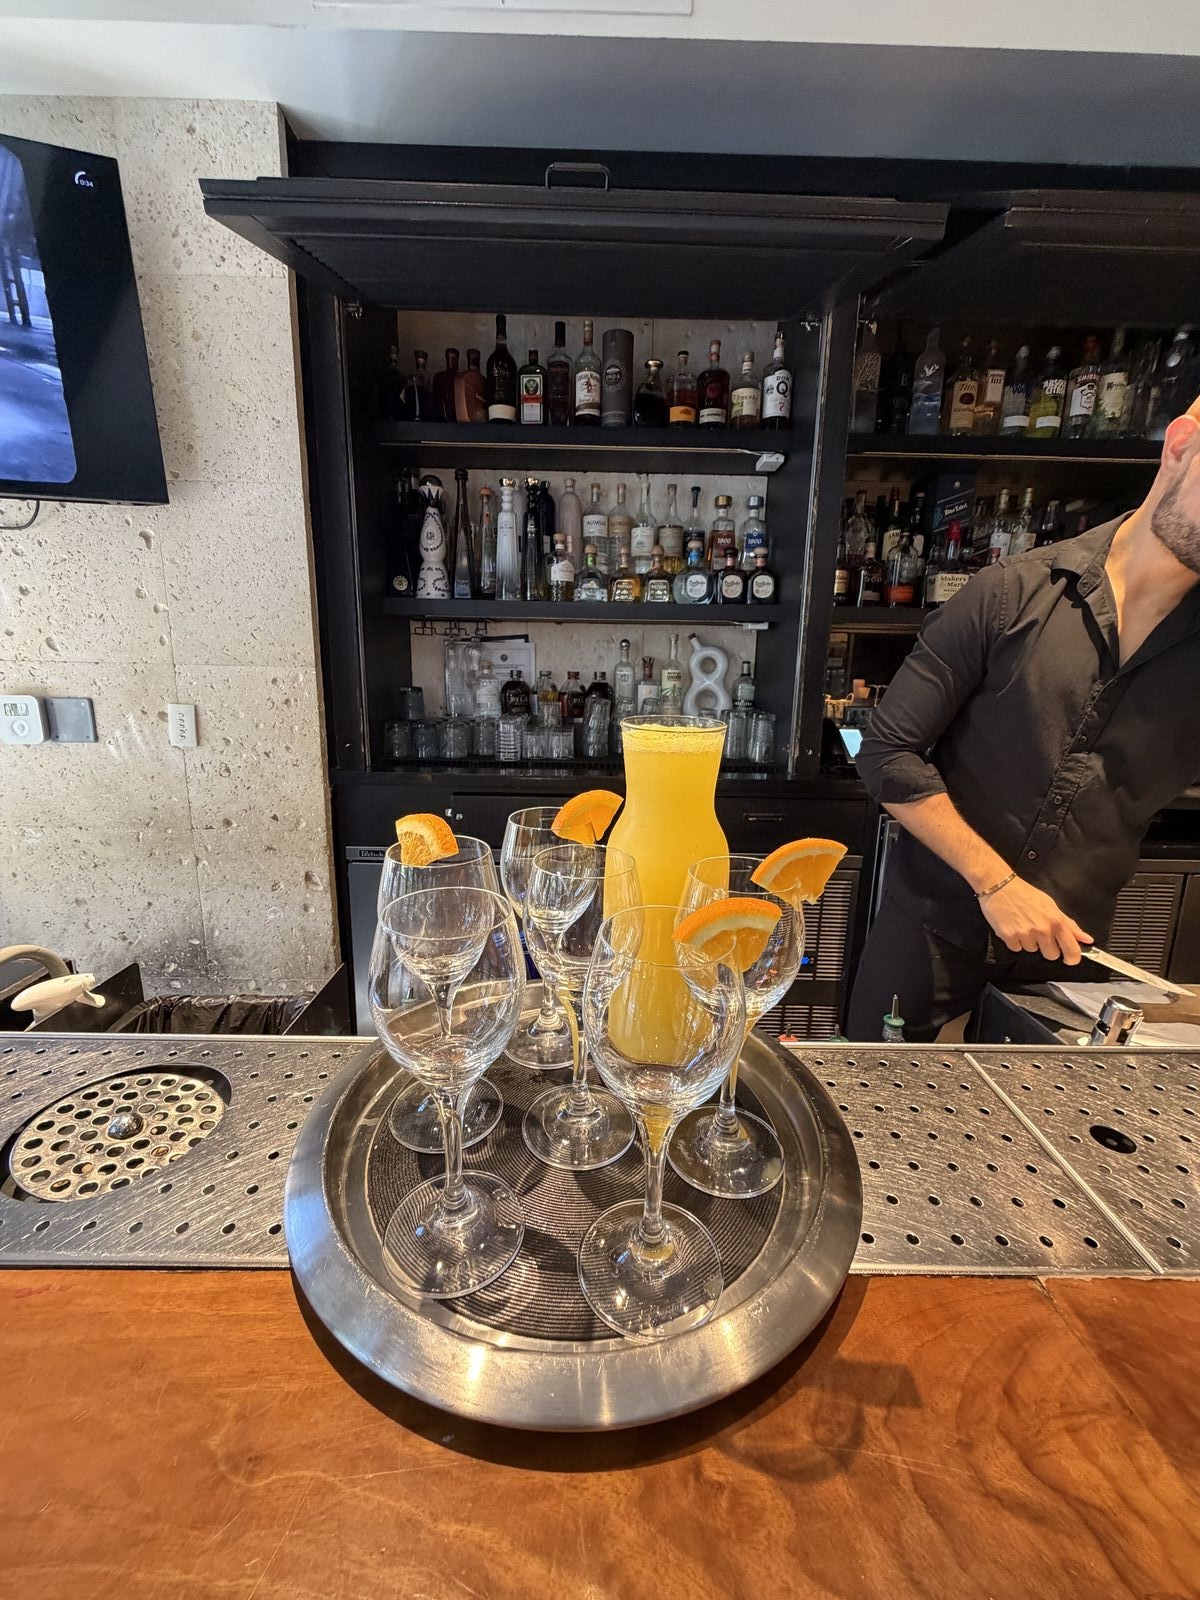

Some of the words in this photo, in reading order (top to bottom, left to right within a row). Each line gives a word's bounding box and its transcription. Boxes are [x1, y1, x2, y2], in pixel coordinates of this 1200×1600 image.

[776, 381, 788, 398] Q
[778, 402, 785, 412] 7
[717, 537, 732, 545] 1800
[748, 537, 763, 545] 1800
